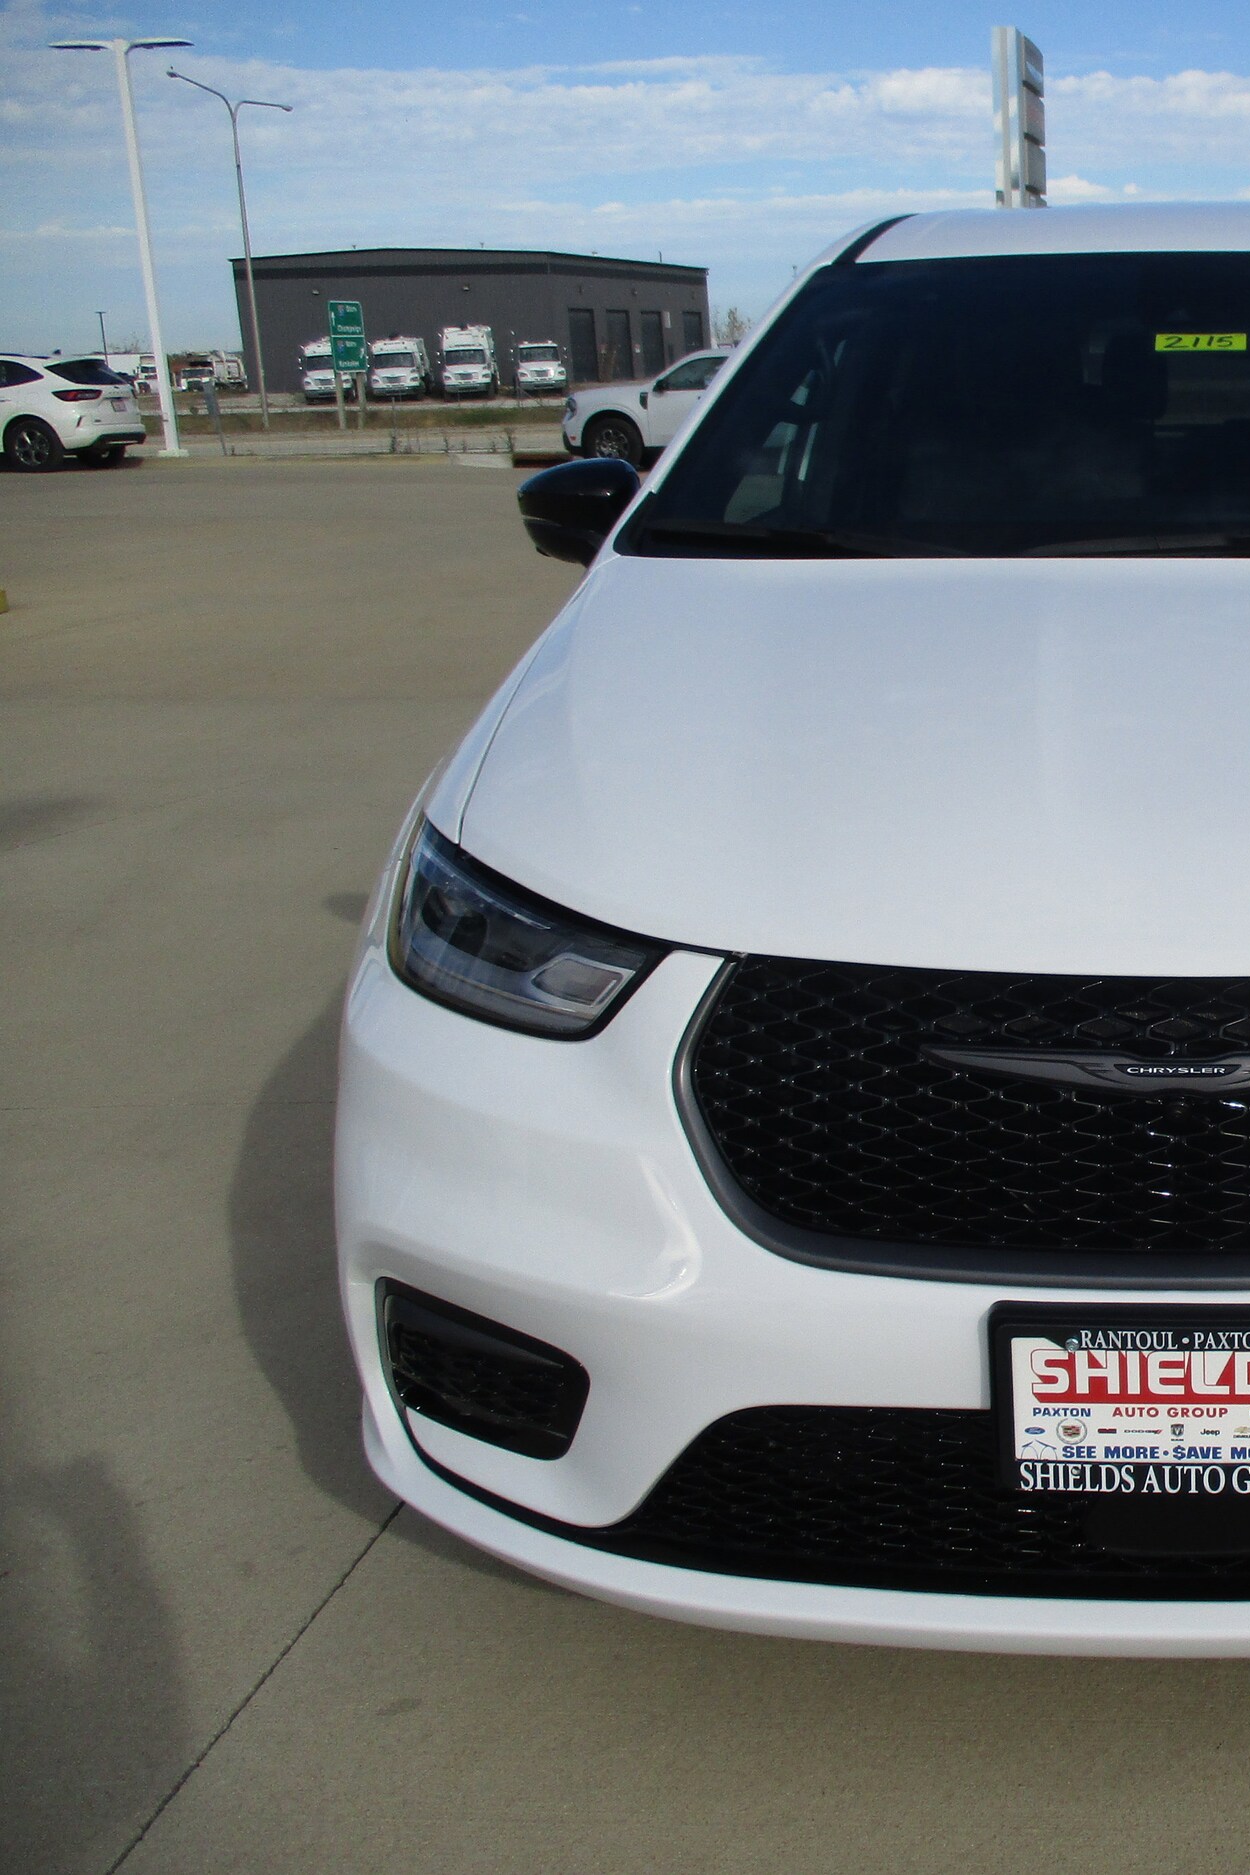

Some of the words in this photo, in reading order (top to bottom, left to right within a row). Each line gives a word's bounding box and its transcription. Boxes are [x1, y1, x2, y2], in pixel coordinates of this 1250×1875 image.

[1163, 336, 1233, 348] 2115
[1080, 1330, 1178, 1350] RANTOUL
[1032, 1407, 1092, 1418] PAXTON
[1112, 1407, 1160, 1418] AUTO
[1167, 1407, 1229, 1418] GROUP
[1200, 1428, 1221, 1436] Jeep
[1062, 1446, 1097, 1459] SEE
[1104, 1446, 1160, 1459] MORE
[1172, 1445, 1222, 1461] $AVE
[1019, 1462, 1135, 1493] SHIELDS
[1141, 1465, 1225, 1494] AUTO
